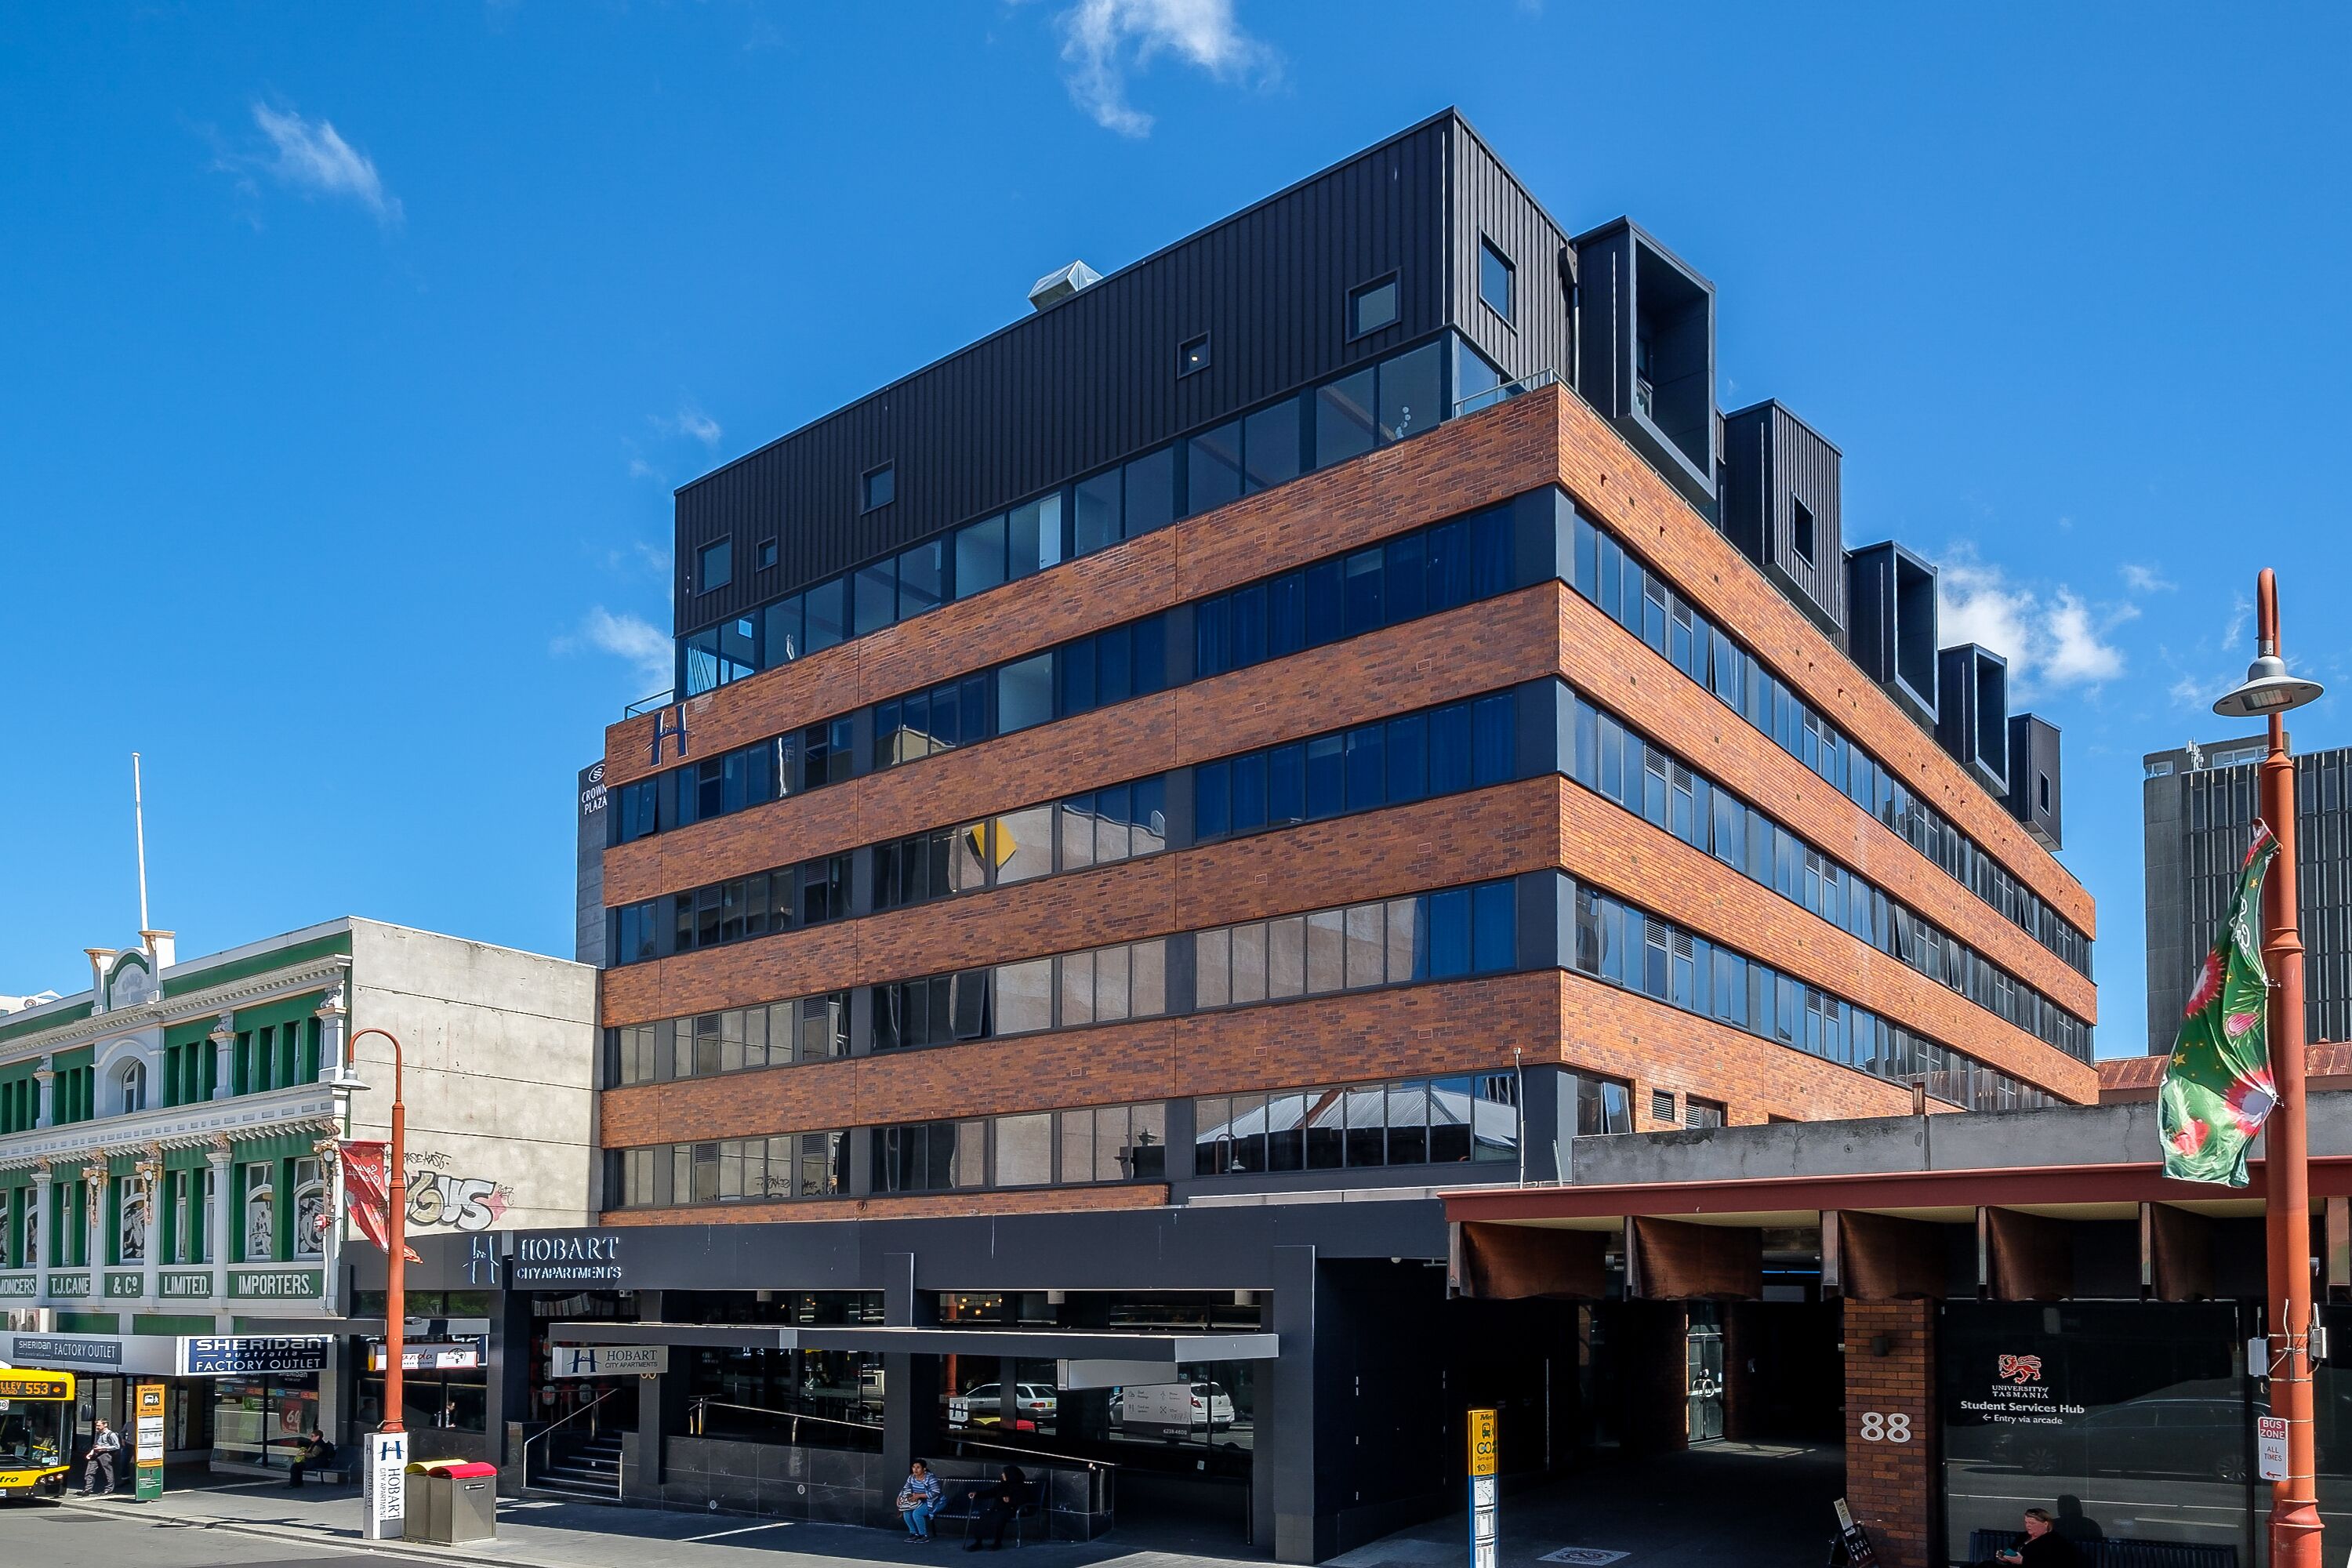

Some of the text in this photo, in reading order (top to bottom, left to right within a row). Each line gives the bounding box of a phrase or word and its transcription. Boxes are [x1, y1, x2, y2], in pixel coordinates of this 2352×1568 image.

[584, 795, 608, 815] PLAZA
[521, 1236, 620, 1261] HOBART
[517, 1266, 622, 1279] CITY APARTMENTS
[113, 1276, 122, 1294] &
[164, 1276, 210, 1294] LIMITED.
[238, 1274, 314, 1294] IMPORTERS.
[54, 1343, 86, 1357] FACTORY
[87, 1345, 116, 1359] OUTLET
[607, 1350, 658, 1361] HOBART
[196, 1359, 321, 1372] FACTORY OUTLET
[0, 1381, 49, 1395] LLEY 553
[1961, 1400, 2085, 1414] Student Services Hub
[1994, 1414, 2016, 1424] Entry
[2263, 1420, 2282, 1429] BUS
[1860, 1412, 1911, 1443] 88
[2260, 1429, 2285, 1439] ZONE
[2264, 1453, 2282, 1462] TIMES
[388, 1468, 401, 1519] HOBART
